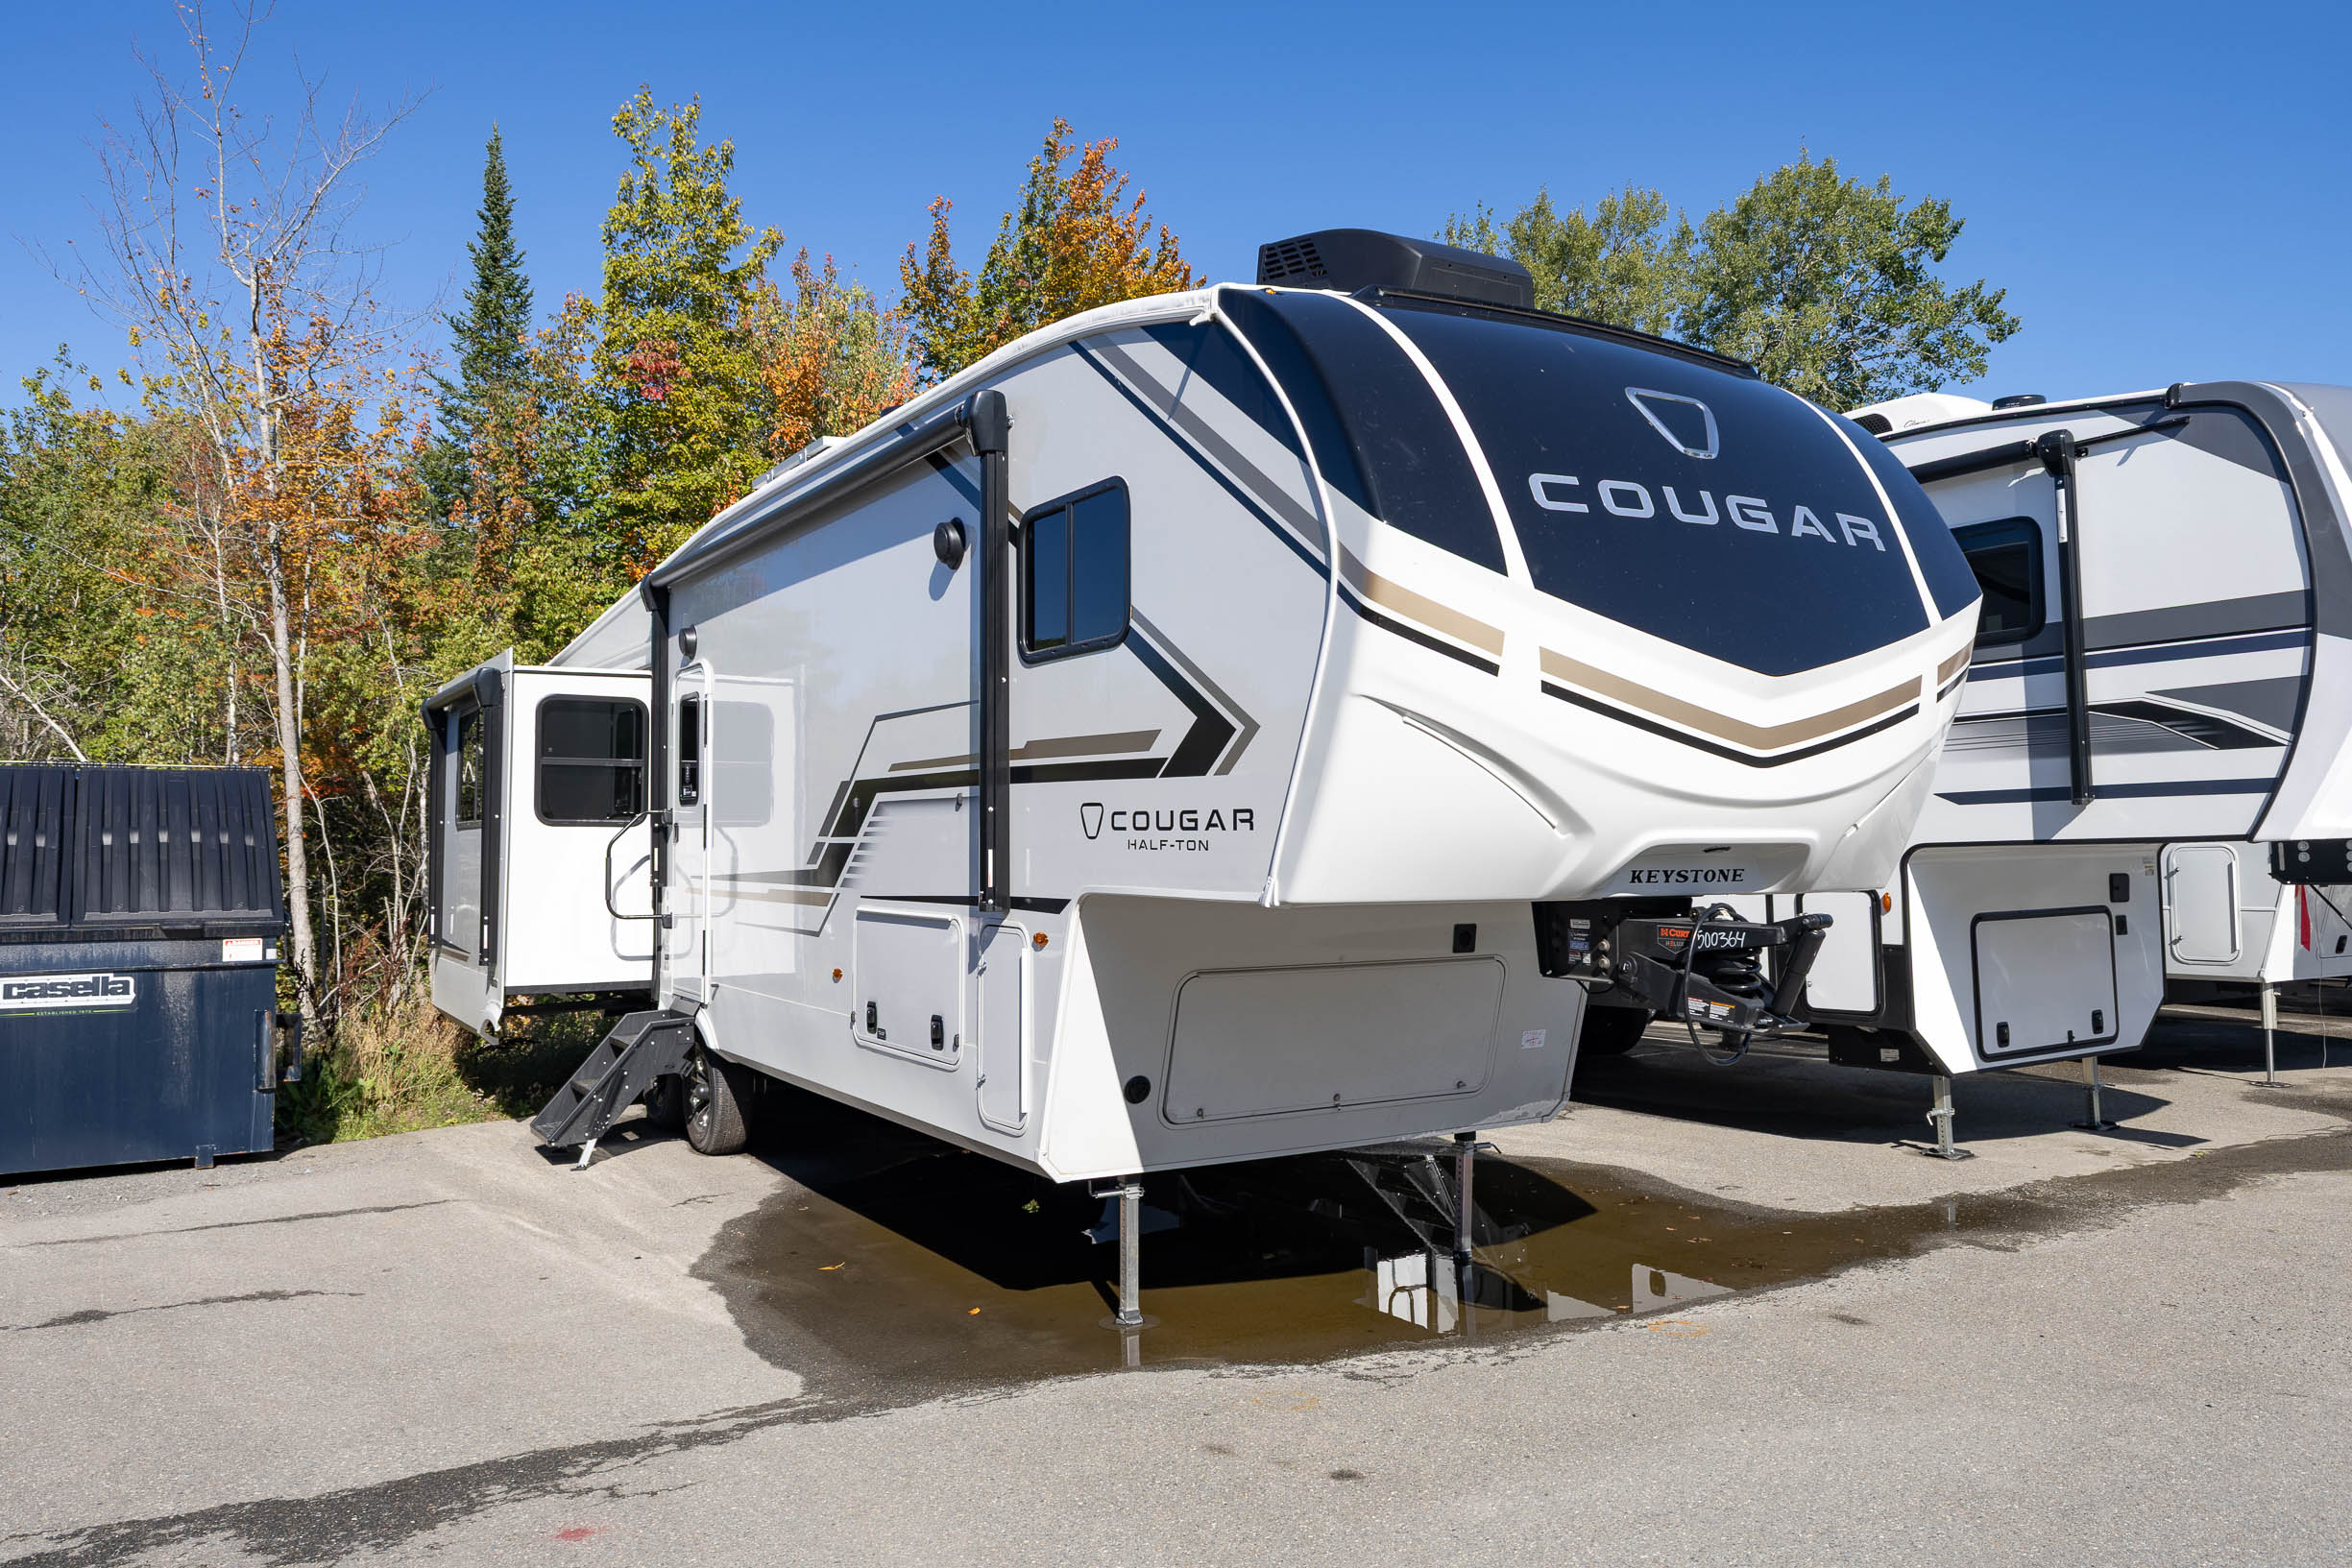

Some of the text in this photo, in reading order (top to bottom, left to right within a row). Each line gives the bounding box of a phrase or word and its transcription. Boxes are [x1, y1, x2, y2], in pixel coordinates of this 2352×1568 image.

[1529, 472, 1886, 551] COUGAR
[1111, 808, 1254, 832] COUGAR
[1128, 839, 1209, 851] HALF-TON
[1629, 869, 1744, 883] KEYSTONE
[1669, 929, 1690, 937] CURT
[1697, 930, 1746, 949] 500364
[3, 976, 131, 1000] casella
